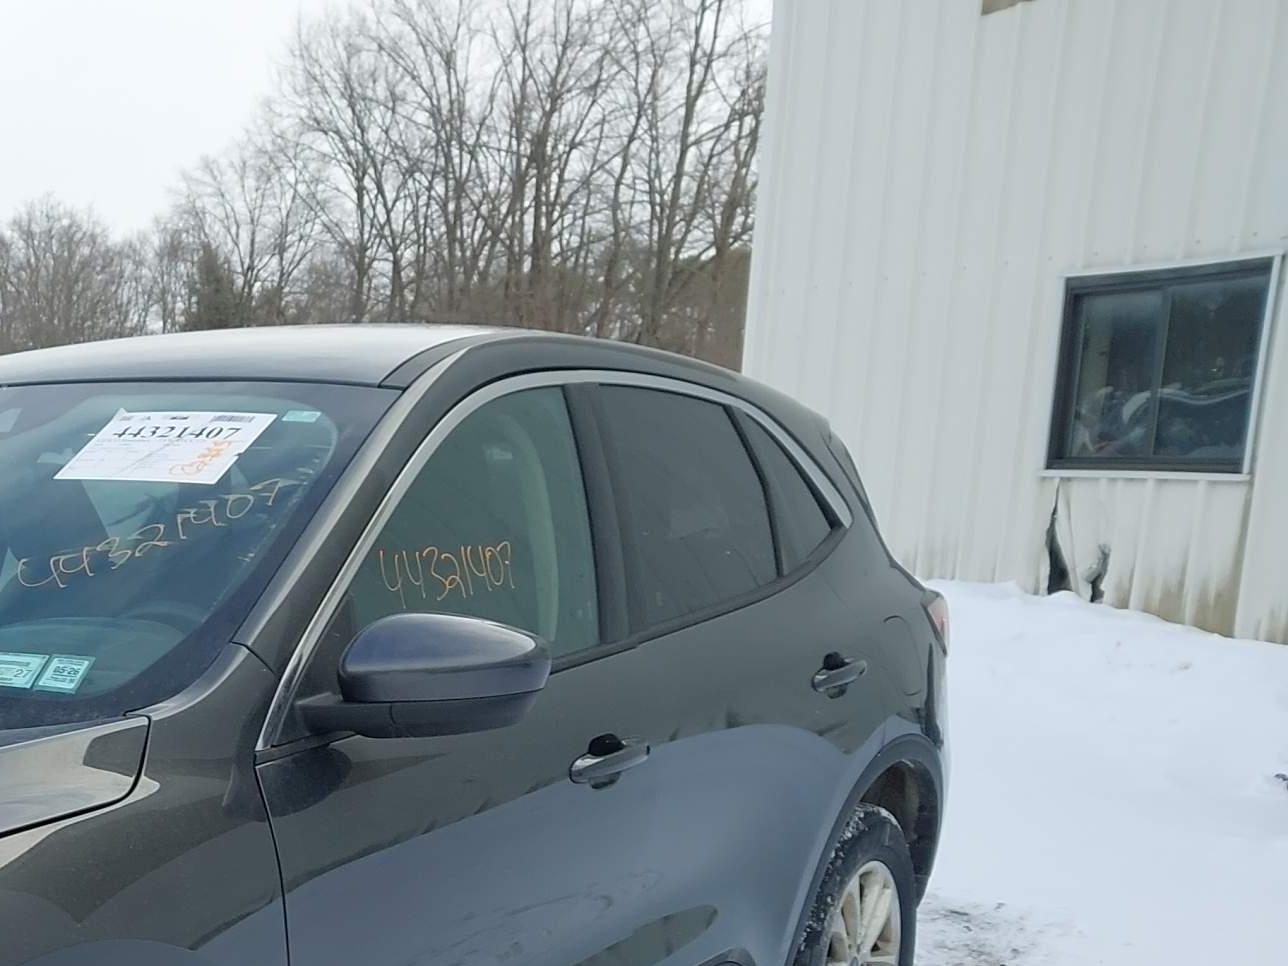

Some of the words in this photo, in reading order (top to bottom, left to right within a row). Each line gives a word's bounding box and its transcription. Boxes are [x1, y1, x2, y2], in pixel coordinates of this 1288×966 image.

[112, 425, 242, 439] 44321407
[17, 478, 302, 588] 44321407
[379, 541, 515, 609] 44321407
[13, 668, 32, 678] 27
